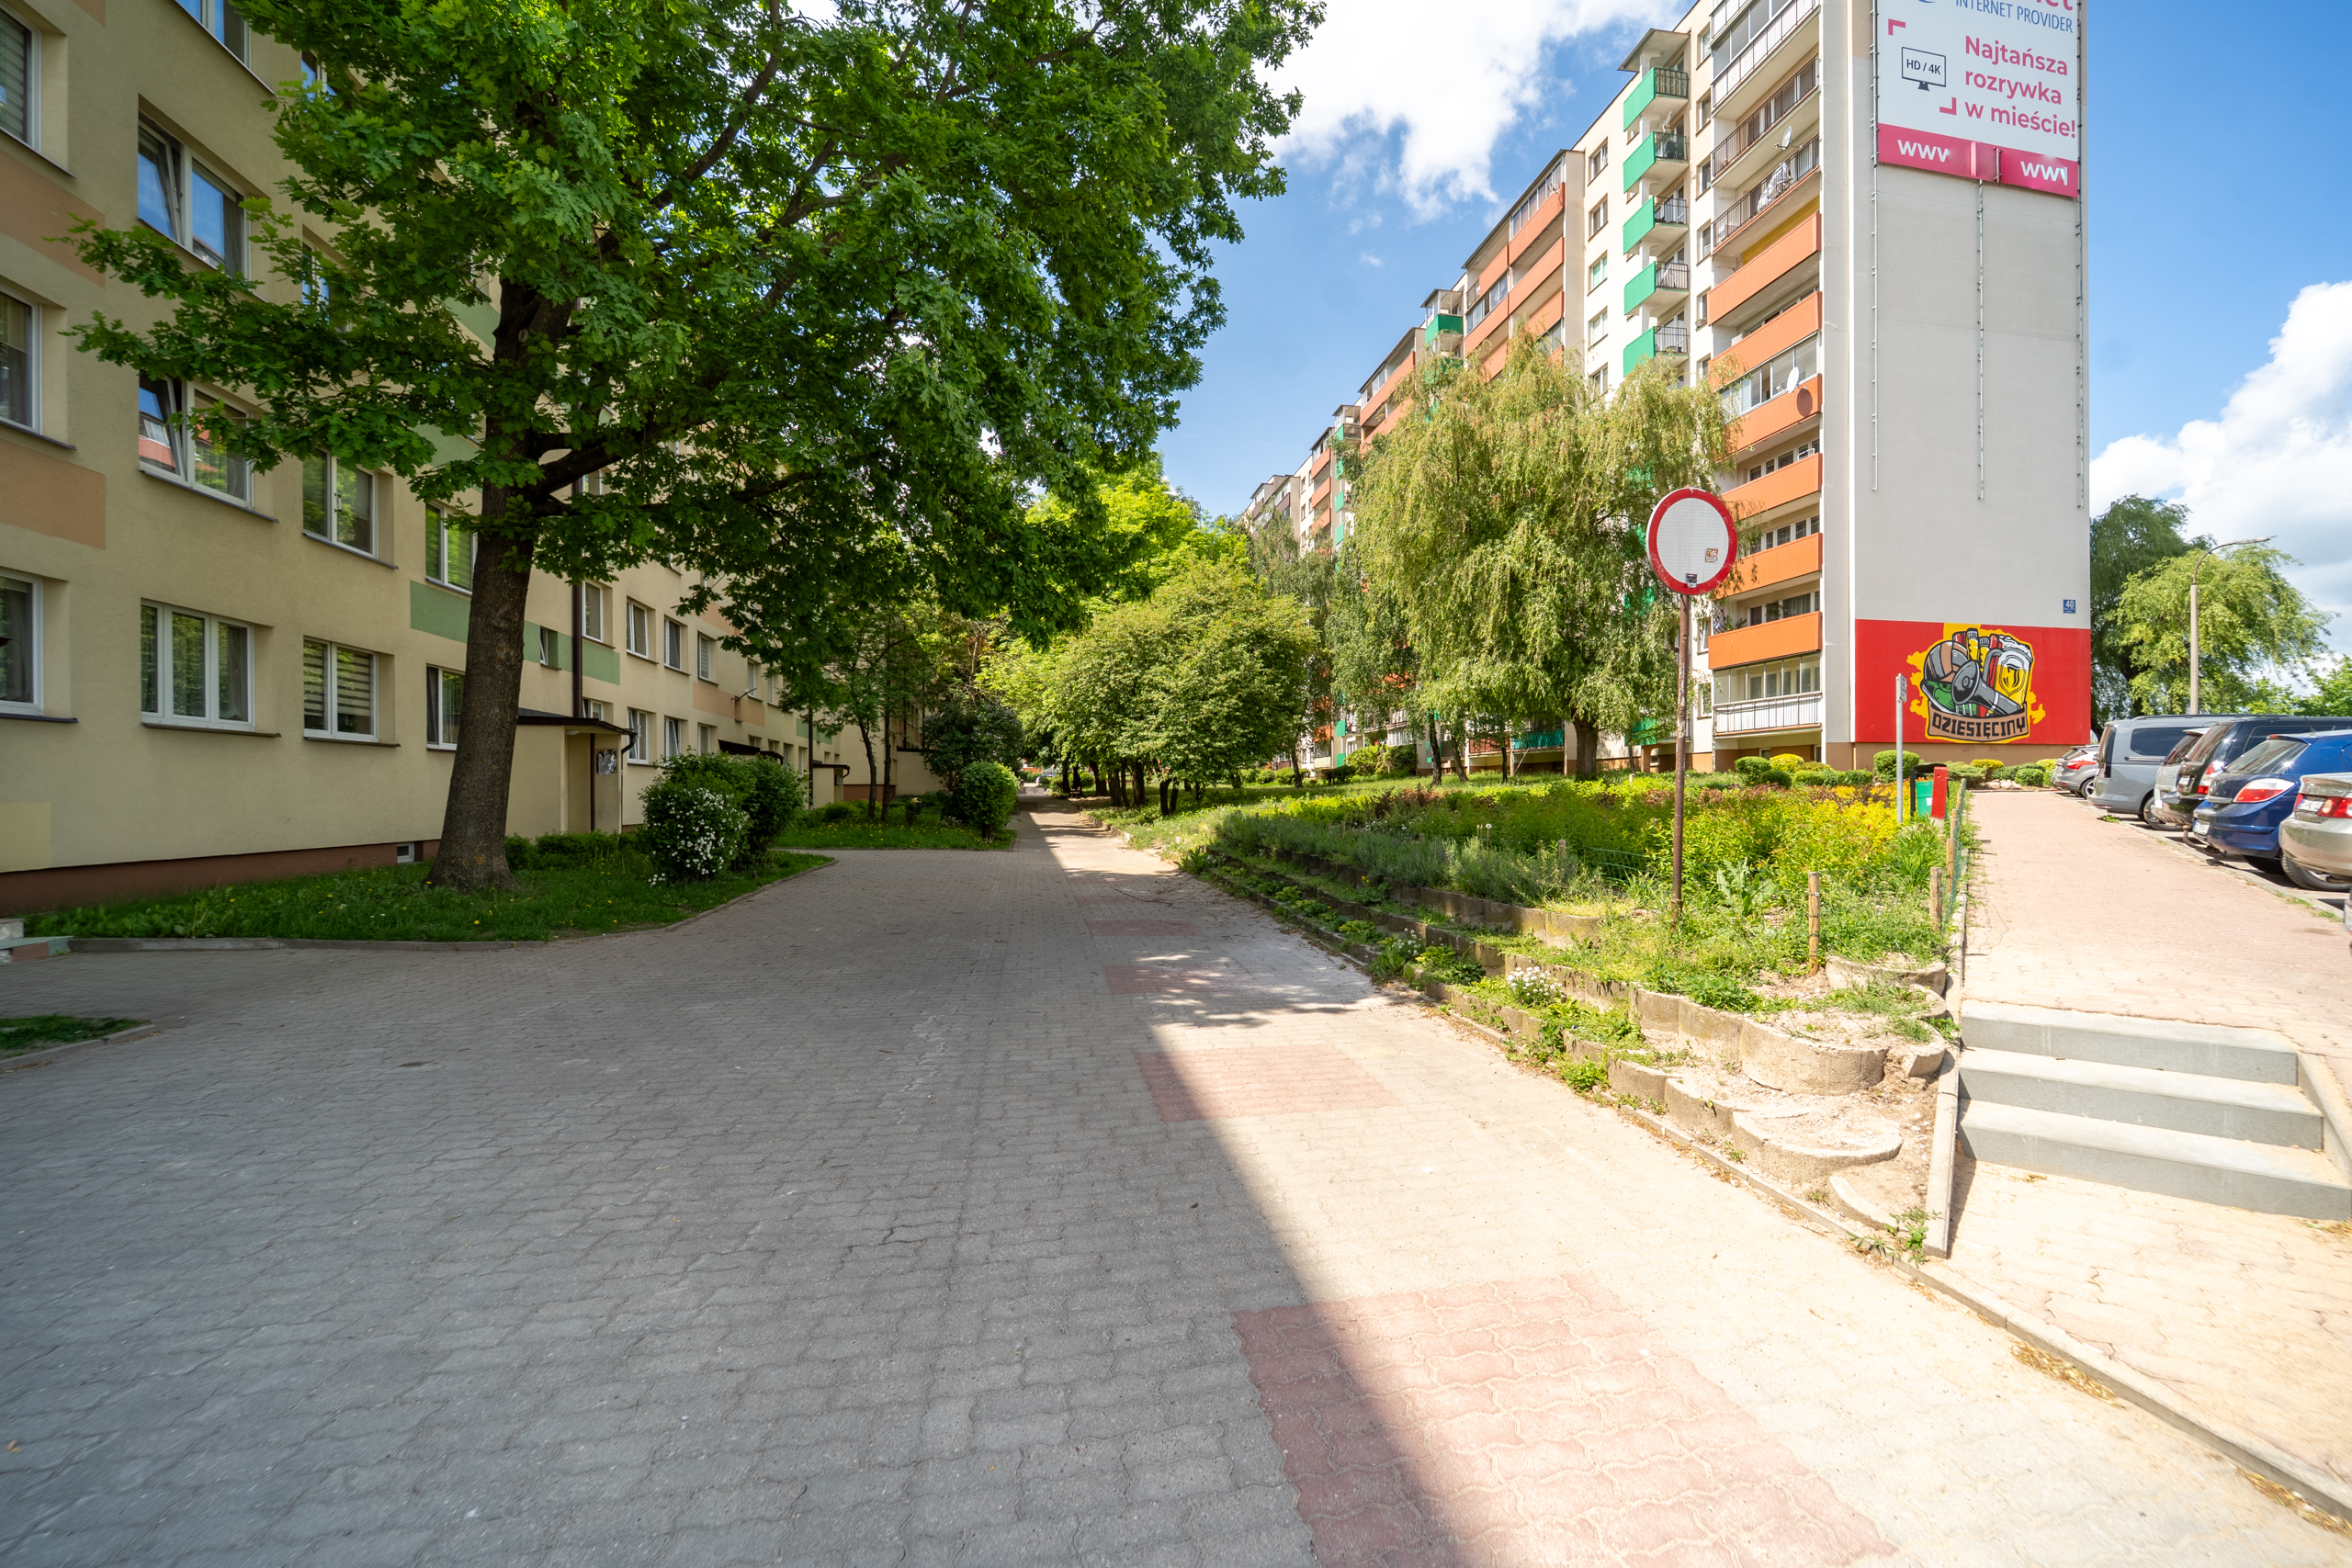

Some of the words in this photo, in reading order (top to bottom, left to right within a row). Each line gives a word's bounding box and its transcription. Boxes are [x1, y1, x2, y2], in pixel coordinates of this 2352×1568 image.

[2017, 6, 2074, 34] PROVIDER
[1906, 58, 1921, 71] HD
[1928, 63, 1941, 75] 4K
[1965, 35, 2068, 76] Najtańsza
[1965, 70, 2062, 105] rozrywka
[1964, 101, 1984, 119] w
[1991, 105, 2076, 139] mieście!
[2065, 600, 2075, 608] 40
[1932, 712, 2026, 739] DZIESIĘCINY
